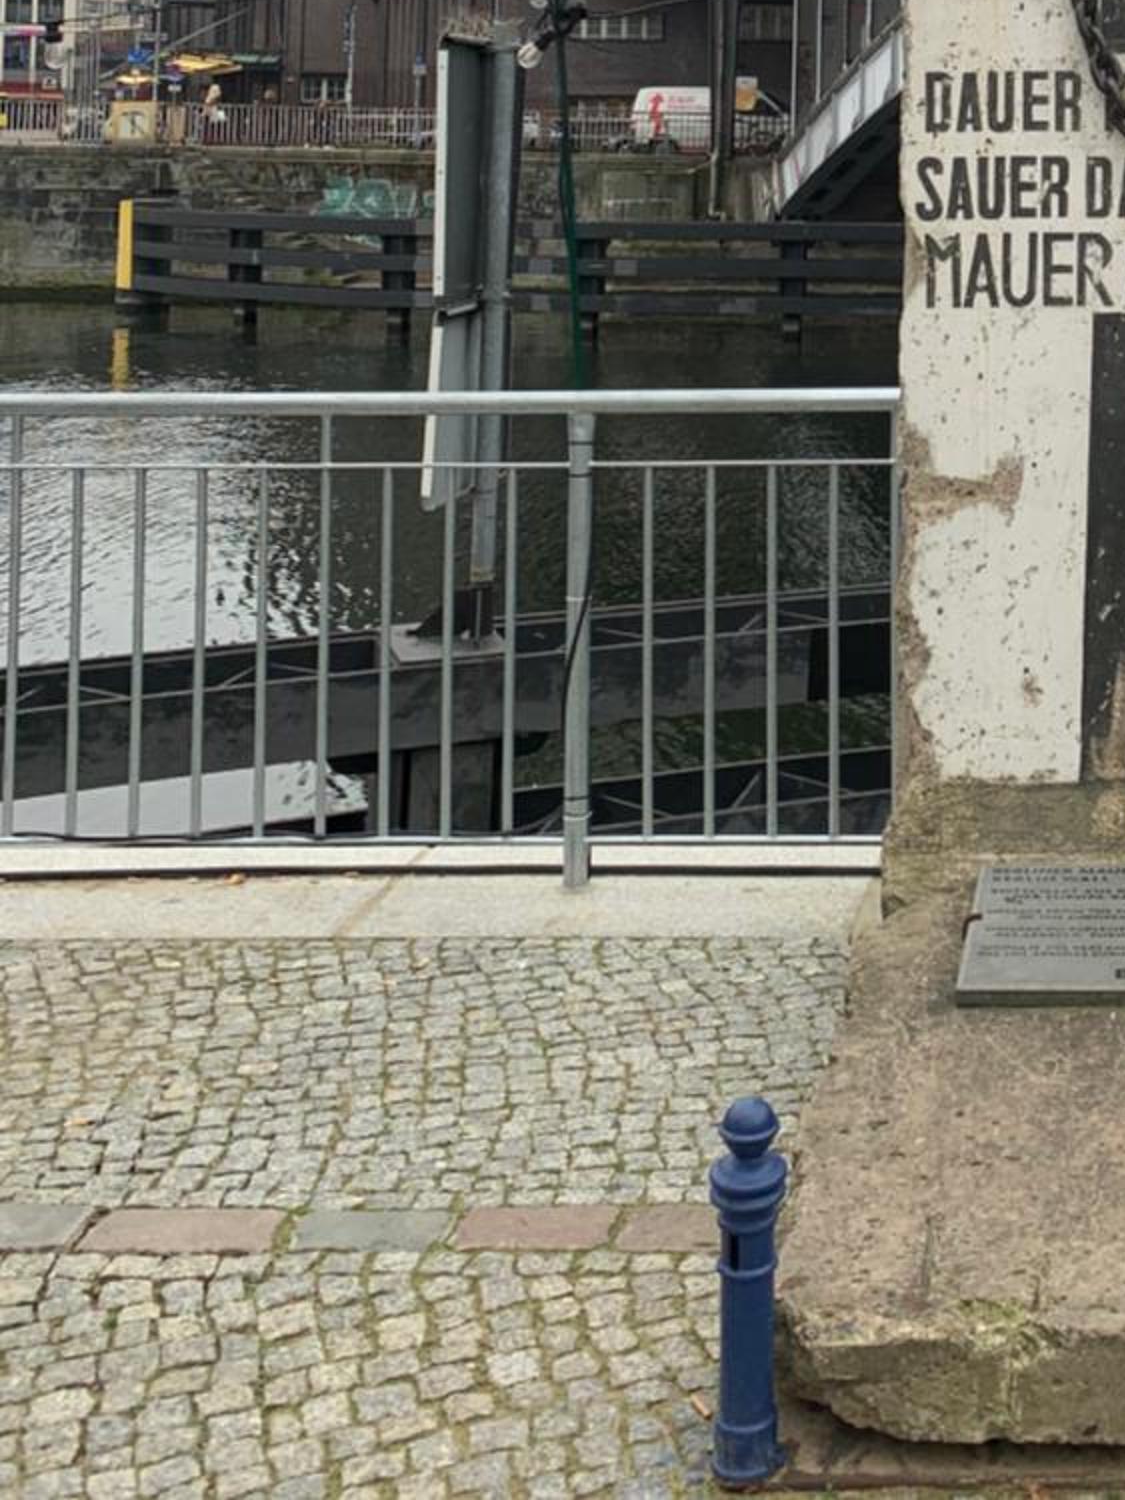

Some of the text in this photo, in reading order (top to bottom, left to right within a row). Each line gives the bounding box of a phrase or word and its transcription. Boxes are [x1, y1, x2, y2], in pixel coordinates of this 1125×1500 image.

[925, 71, 1082, 133] DAUER
[915, 156, 1070, 220] SAUER
[924, 232, 1114, 308] MAUER
